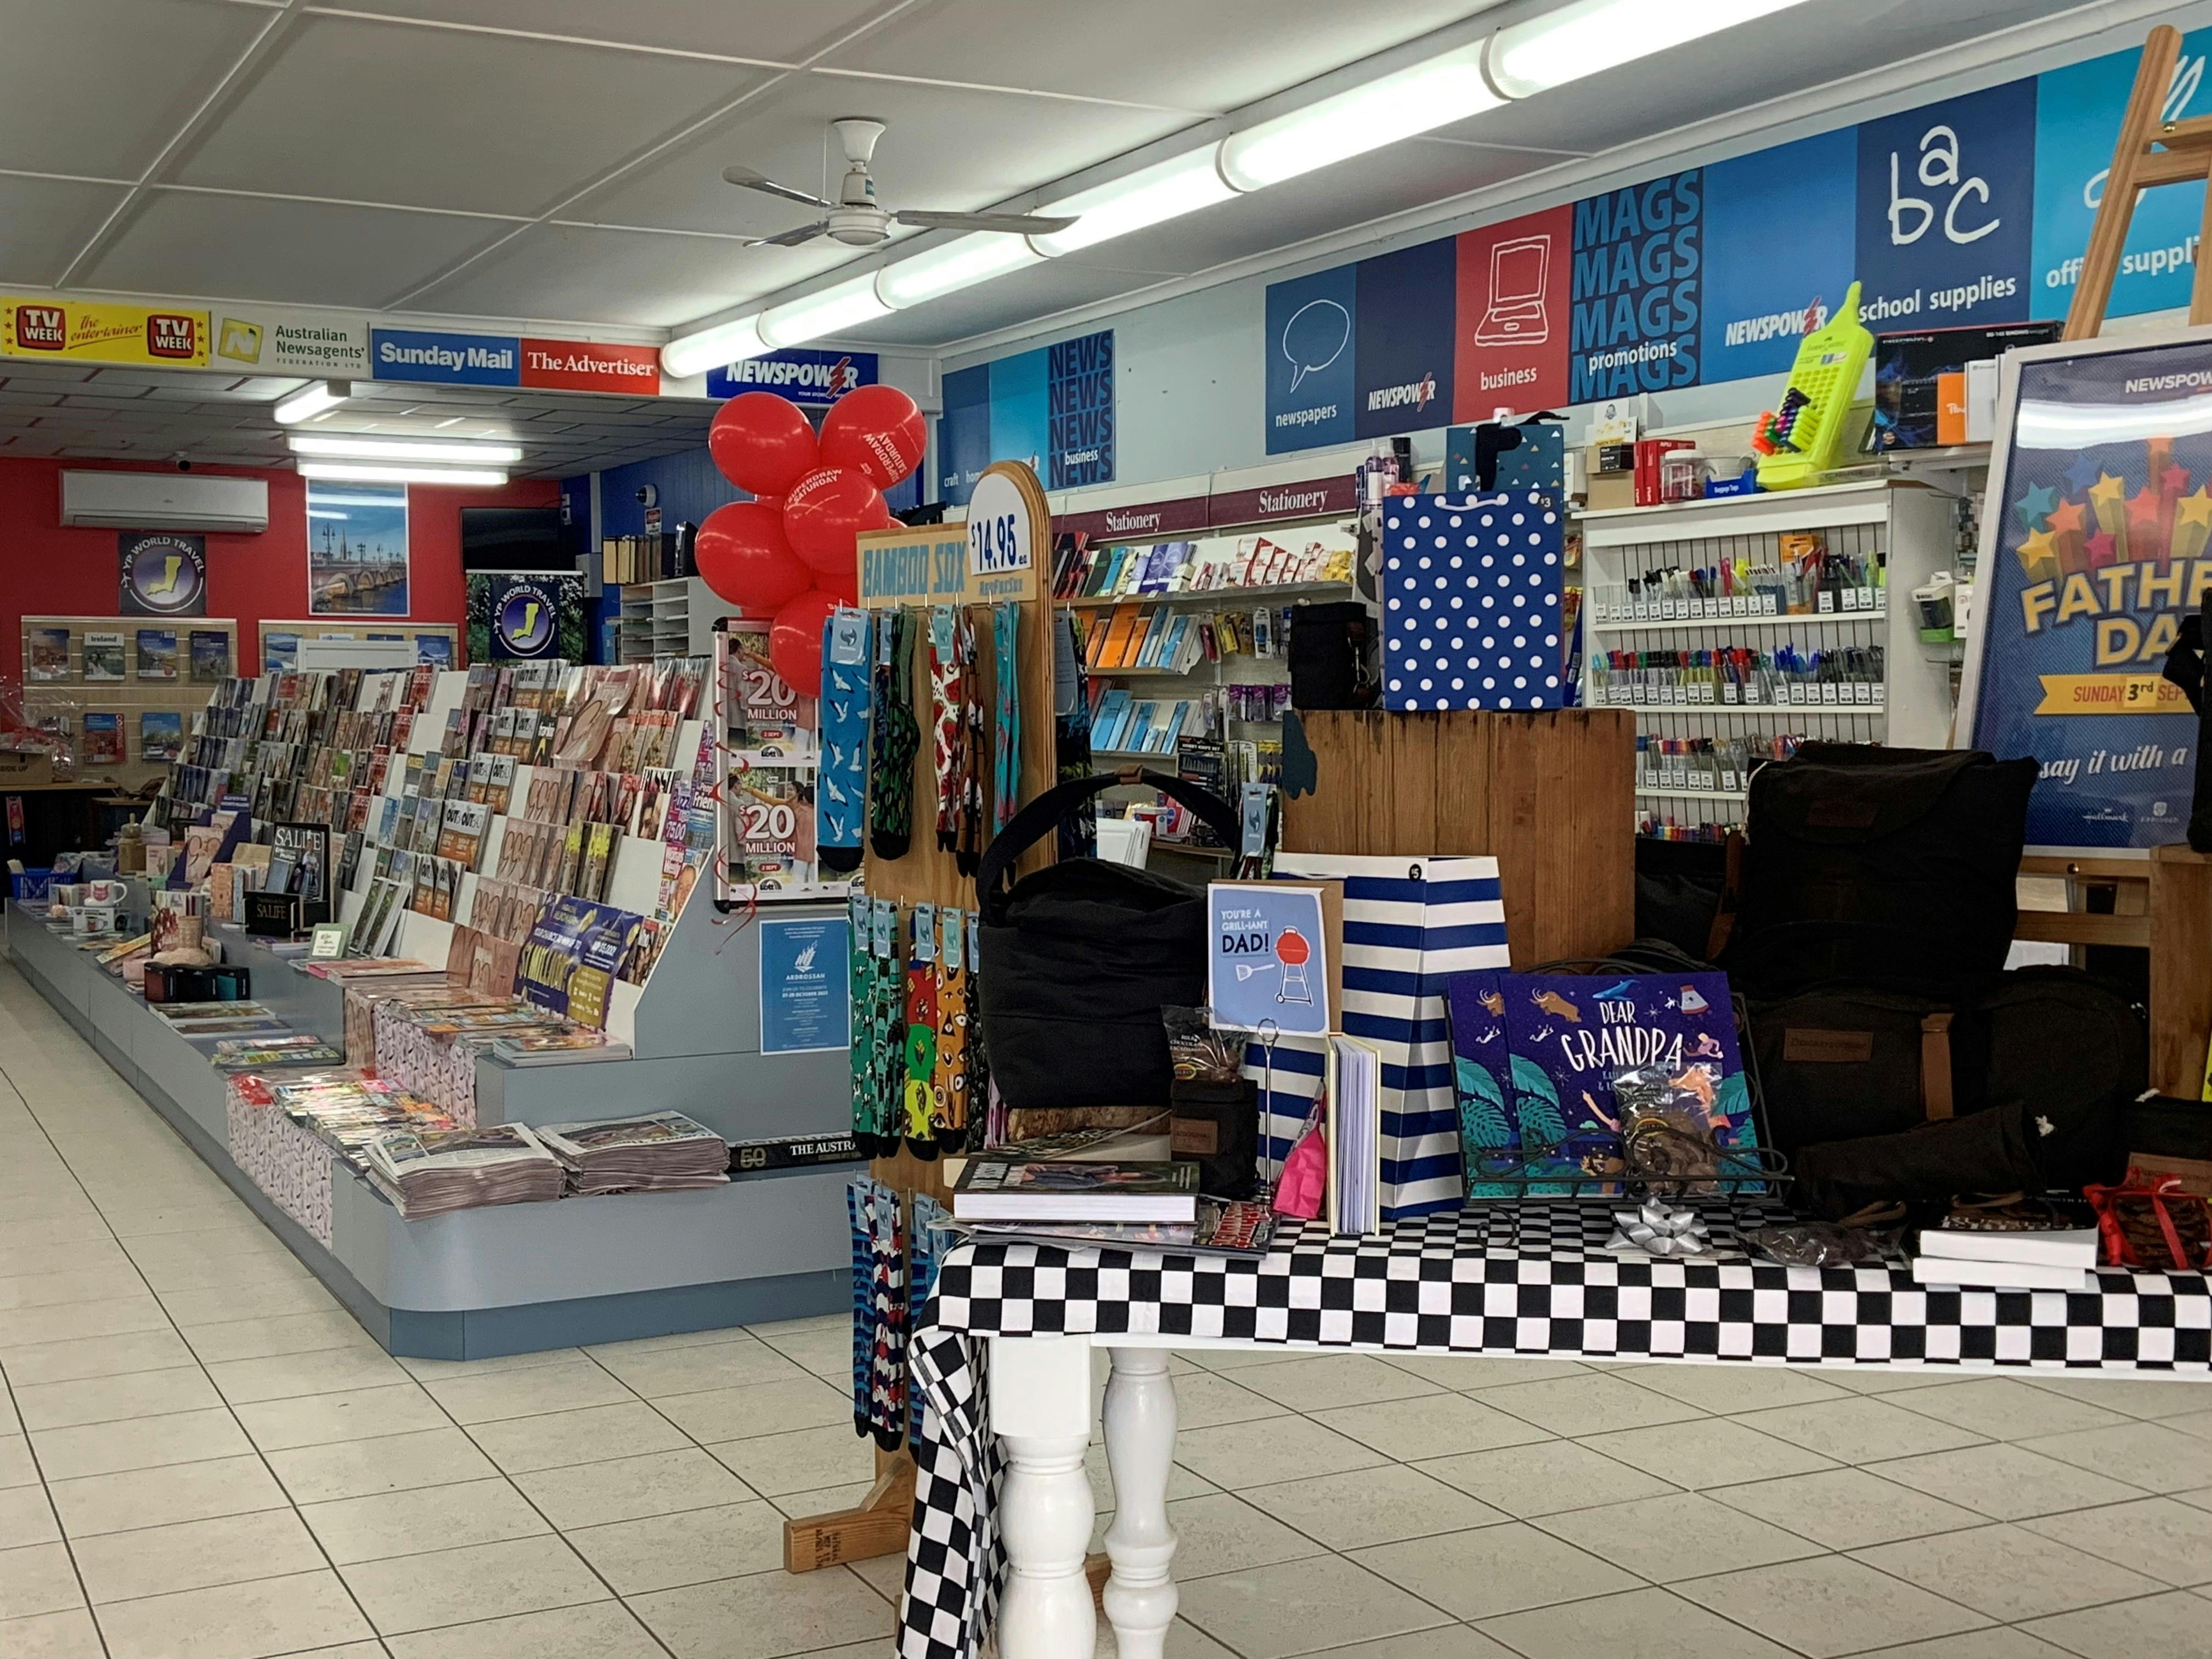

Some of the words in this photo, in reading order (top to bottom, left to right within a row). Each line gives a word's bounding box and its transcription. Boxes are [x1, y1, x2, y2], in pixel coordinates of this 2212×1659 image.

[1576, 171, 1700, 251] MAGS
[1573, 225, 1698, 301] MAGS
[2046, 256, 2085, 289] off
[1859, 289, 1920, 323] school
[1929, 275, 2016, 312] supplies
[26, 309, 60, 327] TV
[156, 318, 189, 336] TV
[1572, 280, 1697, 353] MAGS
[25, 327, 63, 341] WEEK
[70, 324, 143, 341] entertainer
[155, 336, 192, 351] WEEK
[276, 325, 347, 342] Australian
[276, 340, 364, 360] Newsagents'
[380, 343, 466, 371] Sunday
[467, 348, 512, 370] Mail
[1048, 331, 1113, 380] NEWS
[1589, 341, 1677, 376] promotions
[276, 358, 338, 368] FEDERATION
[527, 352, 562, 371] The
[563, 356, 654, 377] Advertiser
[1481, 366, 1537, 391] business
[1048, 370, 1113, 416] NEWS
[1276, 404, 1337, 428] newspapers
[1048, 407, 1113, 452] NEWS
[862, 433, 900, 483] SUPERDRAW
[876, 432, 908, 474] SATURDAY
[1065, 448, 1098, 466] business
[793, 475, 838, 504] SATURDAY
[944, 473, 959, 487] craft
[966, 469, 983, 483] hom
[1259, 490, 1328, 514] Stationery
[1540, 498, 1551, 508] $3
[1106, 511, 1161, 533] Stationery
[122, 554, 134, 570] YP
[132, 537, 171, 555] WORLD
[174, 539, 205, 572] TRAVEL
[971, 514, 1017, 571] $14.95
[863, 544, 929, 597] BAMBOO
[934, 541, 967, 594] SOX
[494, 600, 503, 617] YP
[501, 585, 531, 603] WORLD
[533, 586, 557, 619] TRAVEL
[2021, 560, 2212, 633] FATHE
[91, 635, 117, 644] Ireland
[2096, 613, 2182, 666] DA
[742, 670, 795, 706] $20
[2074, 685, 2126, 702] SUNDAY
[2127, 681, 2154, 701] 3rd
[2158, 685, 2189, 701] SEP
[748, 708, 797, 720] MILLION
[2039, 758, 2080, 785] say
[2088, 749, 2106, 775] it
[2111, 745, 2162, 772] with
[2171, 747, 2188, 766] a
[740, 805, 795, 839] $20
[746, 842, 795, 853] MILLION
[1410, 867, 1419, 878] $5
[1221, 910, 1251, 920] YOU'RE
[1254, 909, 1261, 918] A
[1222, 921, 1268, 932] GRILL-IANT
[1222, 933, 1268, 953] DAD!
[1599, 1001, 1637, 1024] DEAR
[1561, 1025, 1683, 1071] GRANDPA
[741, 1148, 767, 1169] 50
[790, 1143, 814, 1156] THE
